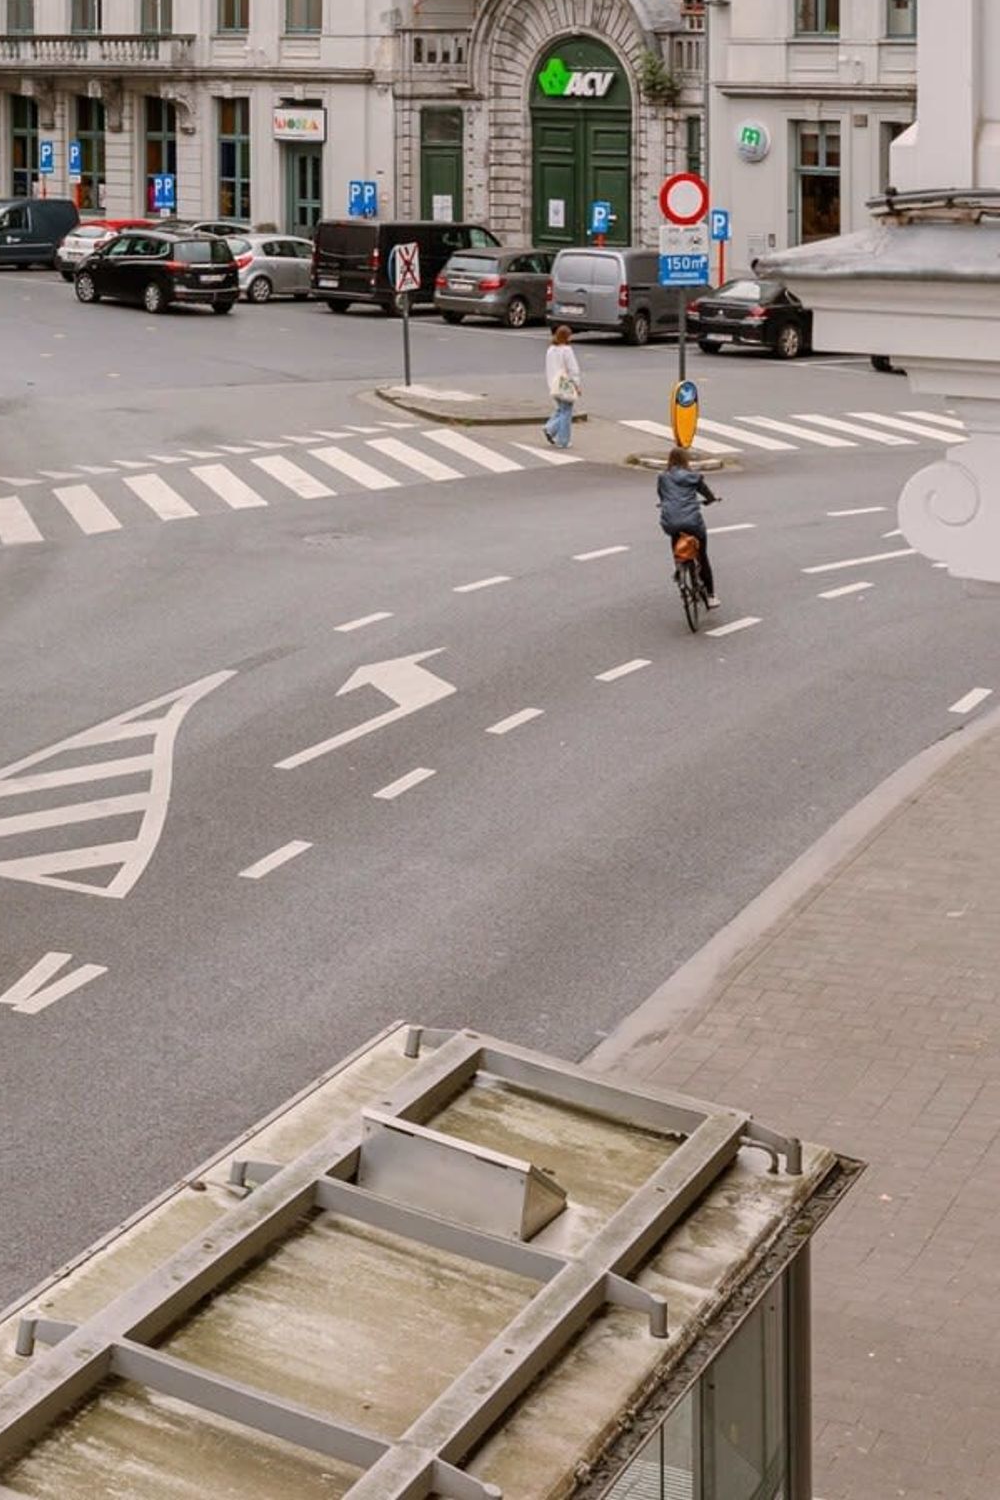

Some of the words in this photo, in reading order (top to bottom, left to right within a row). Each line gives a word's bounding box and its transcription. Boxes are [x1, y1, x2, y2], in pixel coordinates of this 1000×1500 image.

[563, 71, 615, 97] ACV
[41, 144, 51, 162] P
[70, 145, 79, 163] P
[351, 184, 361, 203] P
[364, 185, 375, 204] P
[593, 206, 606, 227] P
[713, 214, 726, 235] P
